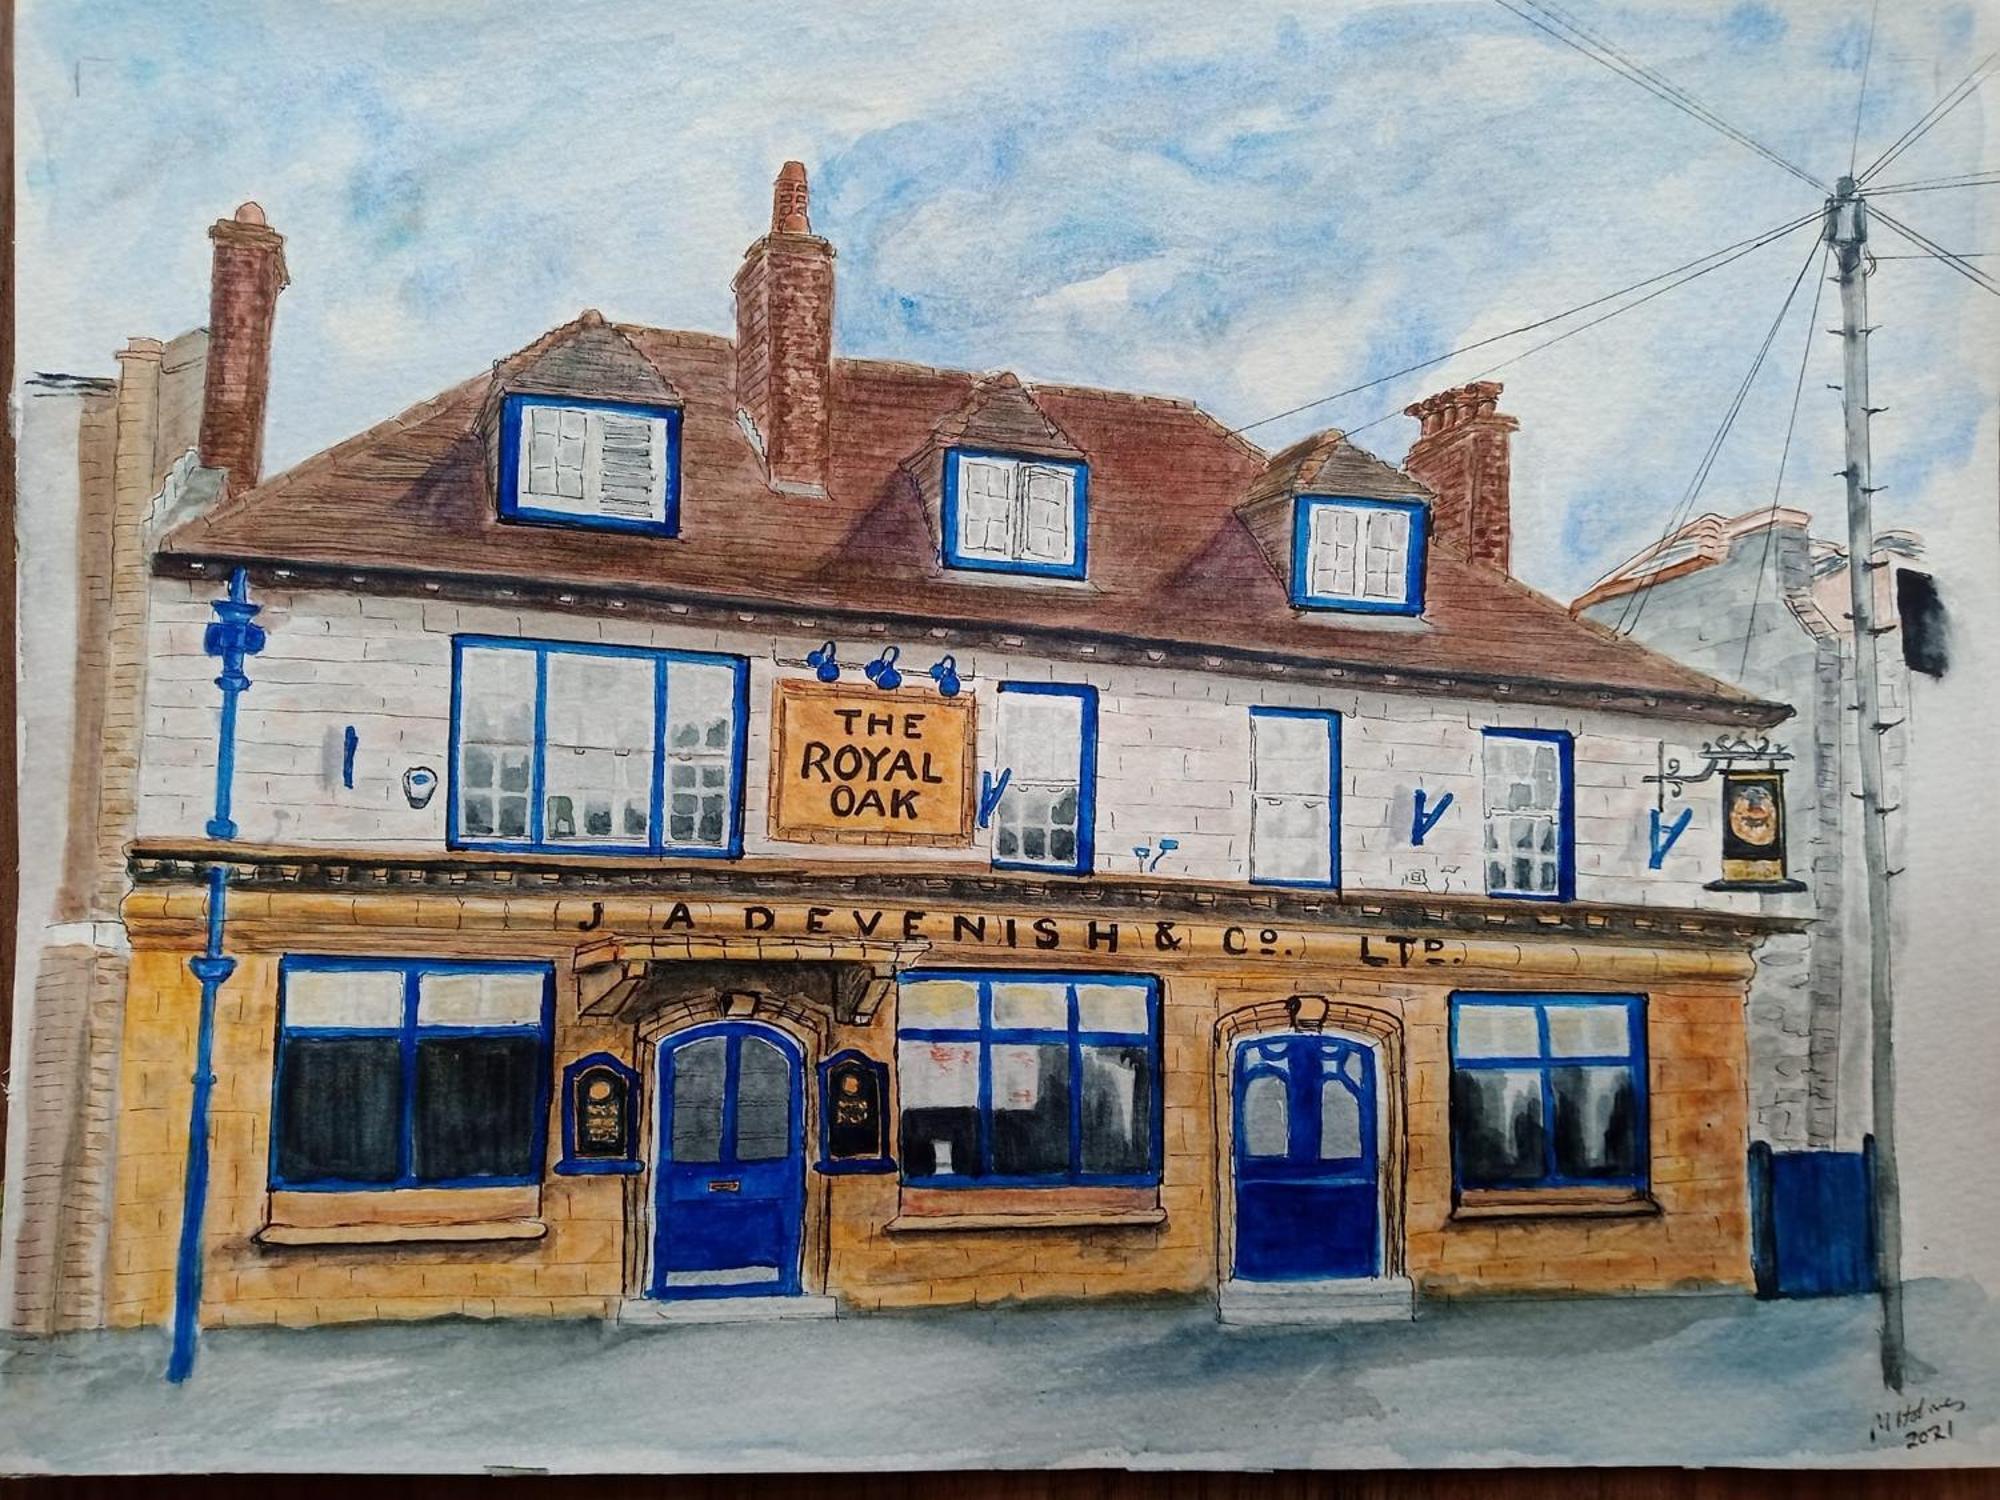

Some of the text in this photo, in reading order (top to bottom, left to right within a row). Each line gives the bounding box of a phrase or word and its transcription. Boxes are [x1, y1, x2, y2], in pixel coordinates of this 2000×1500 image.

[834, 709, 926, 738] THE
[801, 741, 943, 783] ROYAL
[830, 784, 921, 820] OAK
[578, 902, 603, 931] J
[662, 902, 695, 930] A
[744, 907, 1119, 953] DEVENISH
[1154, 922, 1182, 952] &
[1904, 1420, 1953, 1450] 2021
